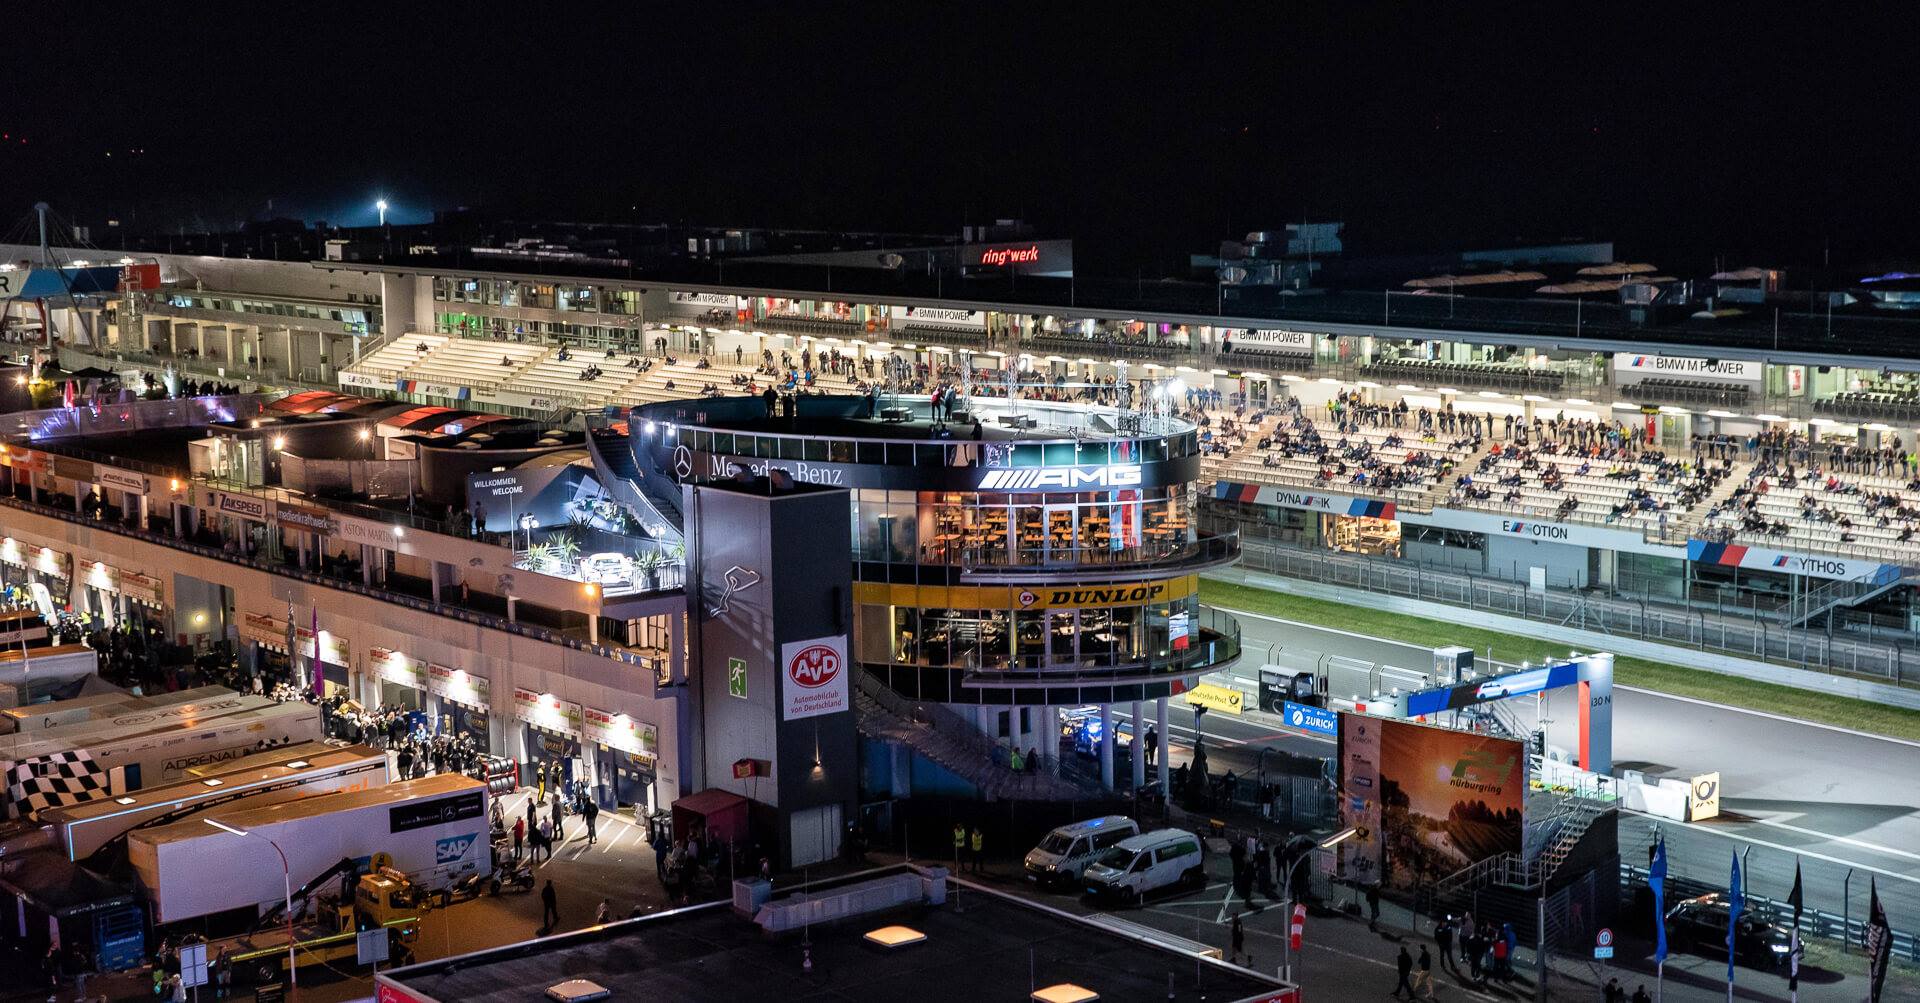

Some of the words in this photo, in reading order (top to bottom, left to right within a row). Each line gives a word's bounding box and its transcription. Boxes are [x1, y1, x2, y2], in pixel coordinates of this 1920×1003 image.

[919, 309, 937, 318] BMW
[938, 310, 944, 319] M
[944, 310, 970, 321] POWER
[1239, 331, 1261, 340] BMW
[1263, 332, 1270, 341] M
[1272, 332, 1304, 344] POWER
[1656, 358, 1685, 370] BMW
[1687, 360, 1697, 371] M
[1700, 361, 1744, 375] POWER
[474, 477, 516, 489] WILLKOMMEN
[1030, 465, 1141, 489] AMG
[492, 485, 523, 496] WELCOME
[219, 493, 262, 514] ZAKSPEED
[277, 509, 328, 529] medienkraftwerk
[345, 523, 365, 537] ASTON
[368, 527, 394, 543] MARTIN
[1049, 584, 1163, 605] DUNLOP
[794, 690, 839, 704] Automobilclub
[1214, 695, 1227, 704] Post
[1604, 695, 1611, 704] N
[791, 706, 802, 714] von
[804, 699, 842, 712] Deutschland
[1305, 715, 1334, 730] ZURICH
[1450, 778, 1502, 795] nürburgring
[437, 840, 469, 860] SAP
